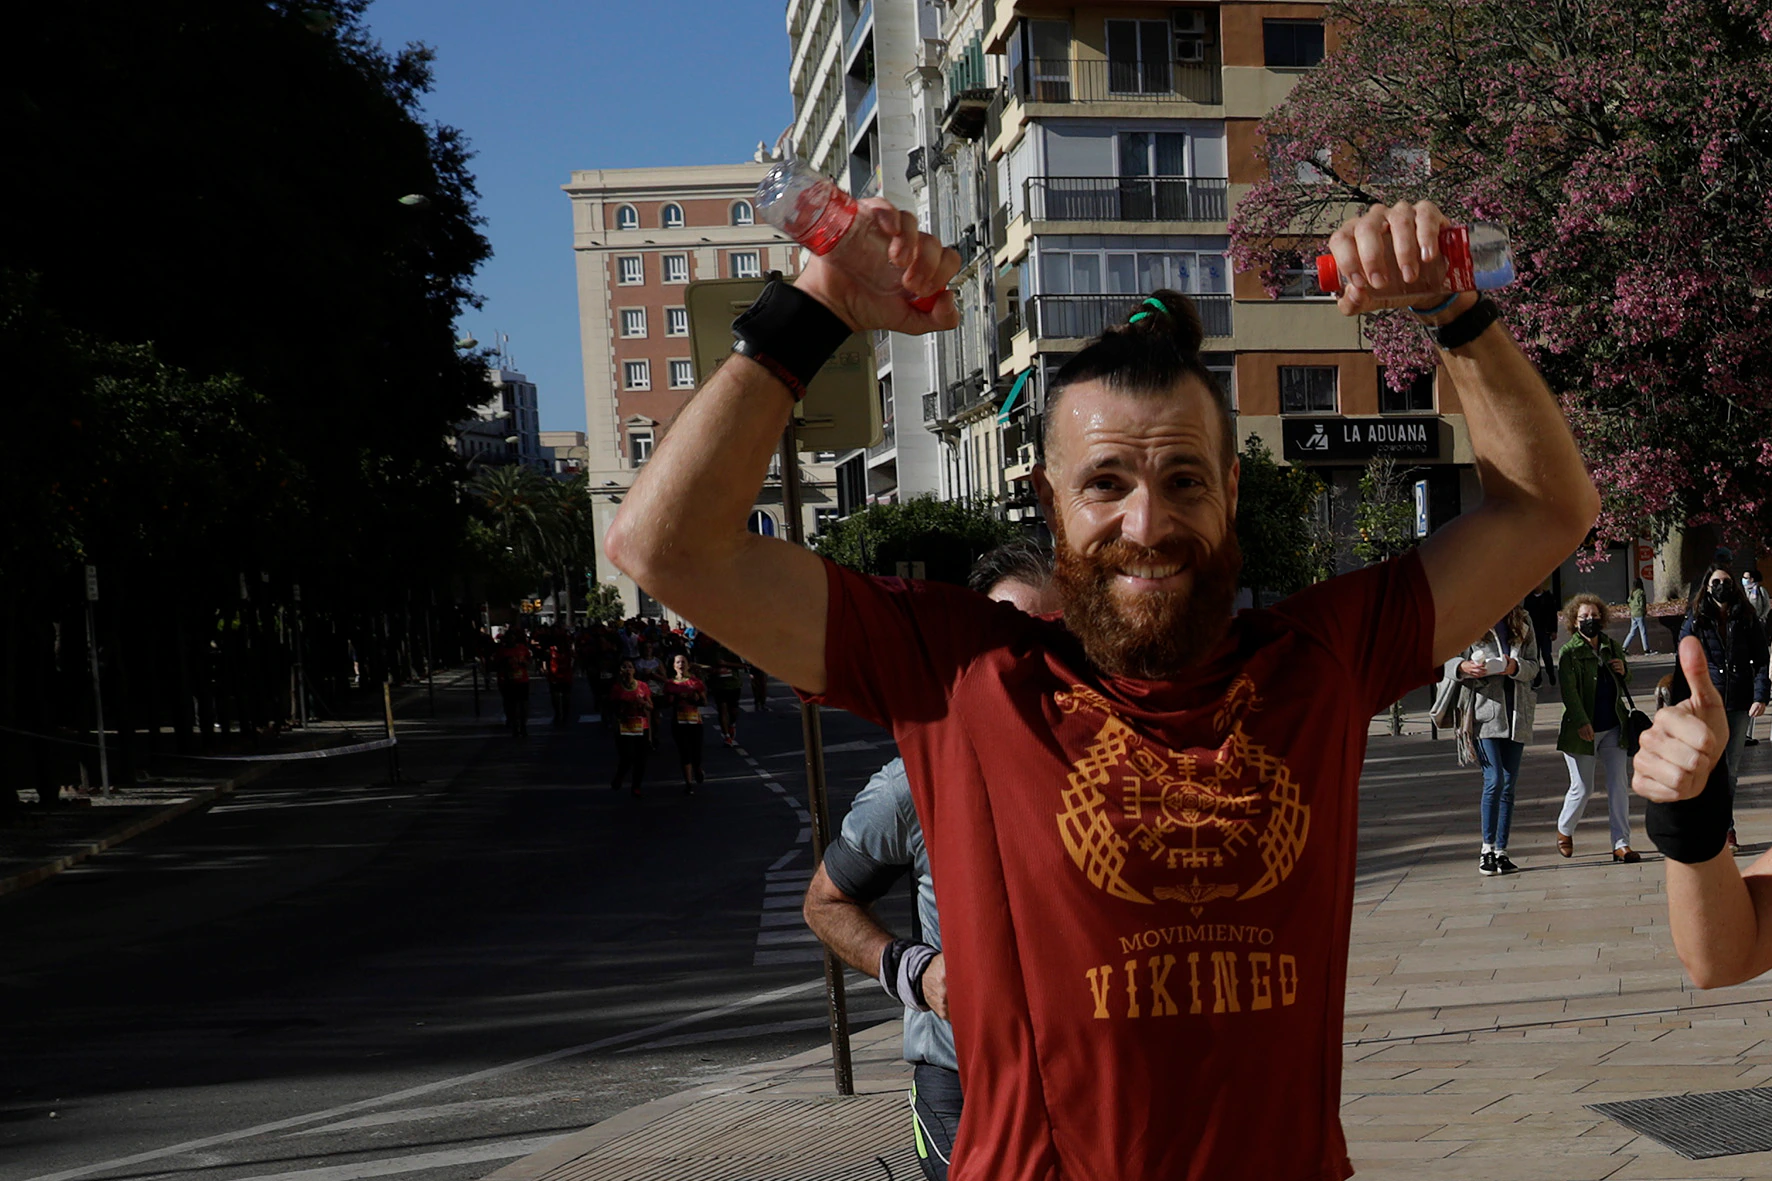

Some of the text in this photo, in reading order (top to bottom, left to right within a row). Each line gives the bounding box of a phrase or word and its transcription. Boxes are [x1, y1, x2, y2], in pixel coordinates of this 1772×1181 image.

[1343, 424, 1427, 442] LA ADUANA
[1377, 444, 1427, 453] coworking
[1118, 924, 1274, 954] MOVIMIENTO
[1085, 951, 1298, 1019] VIKINGO
